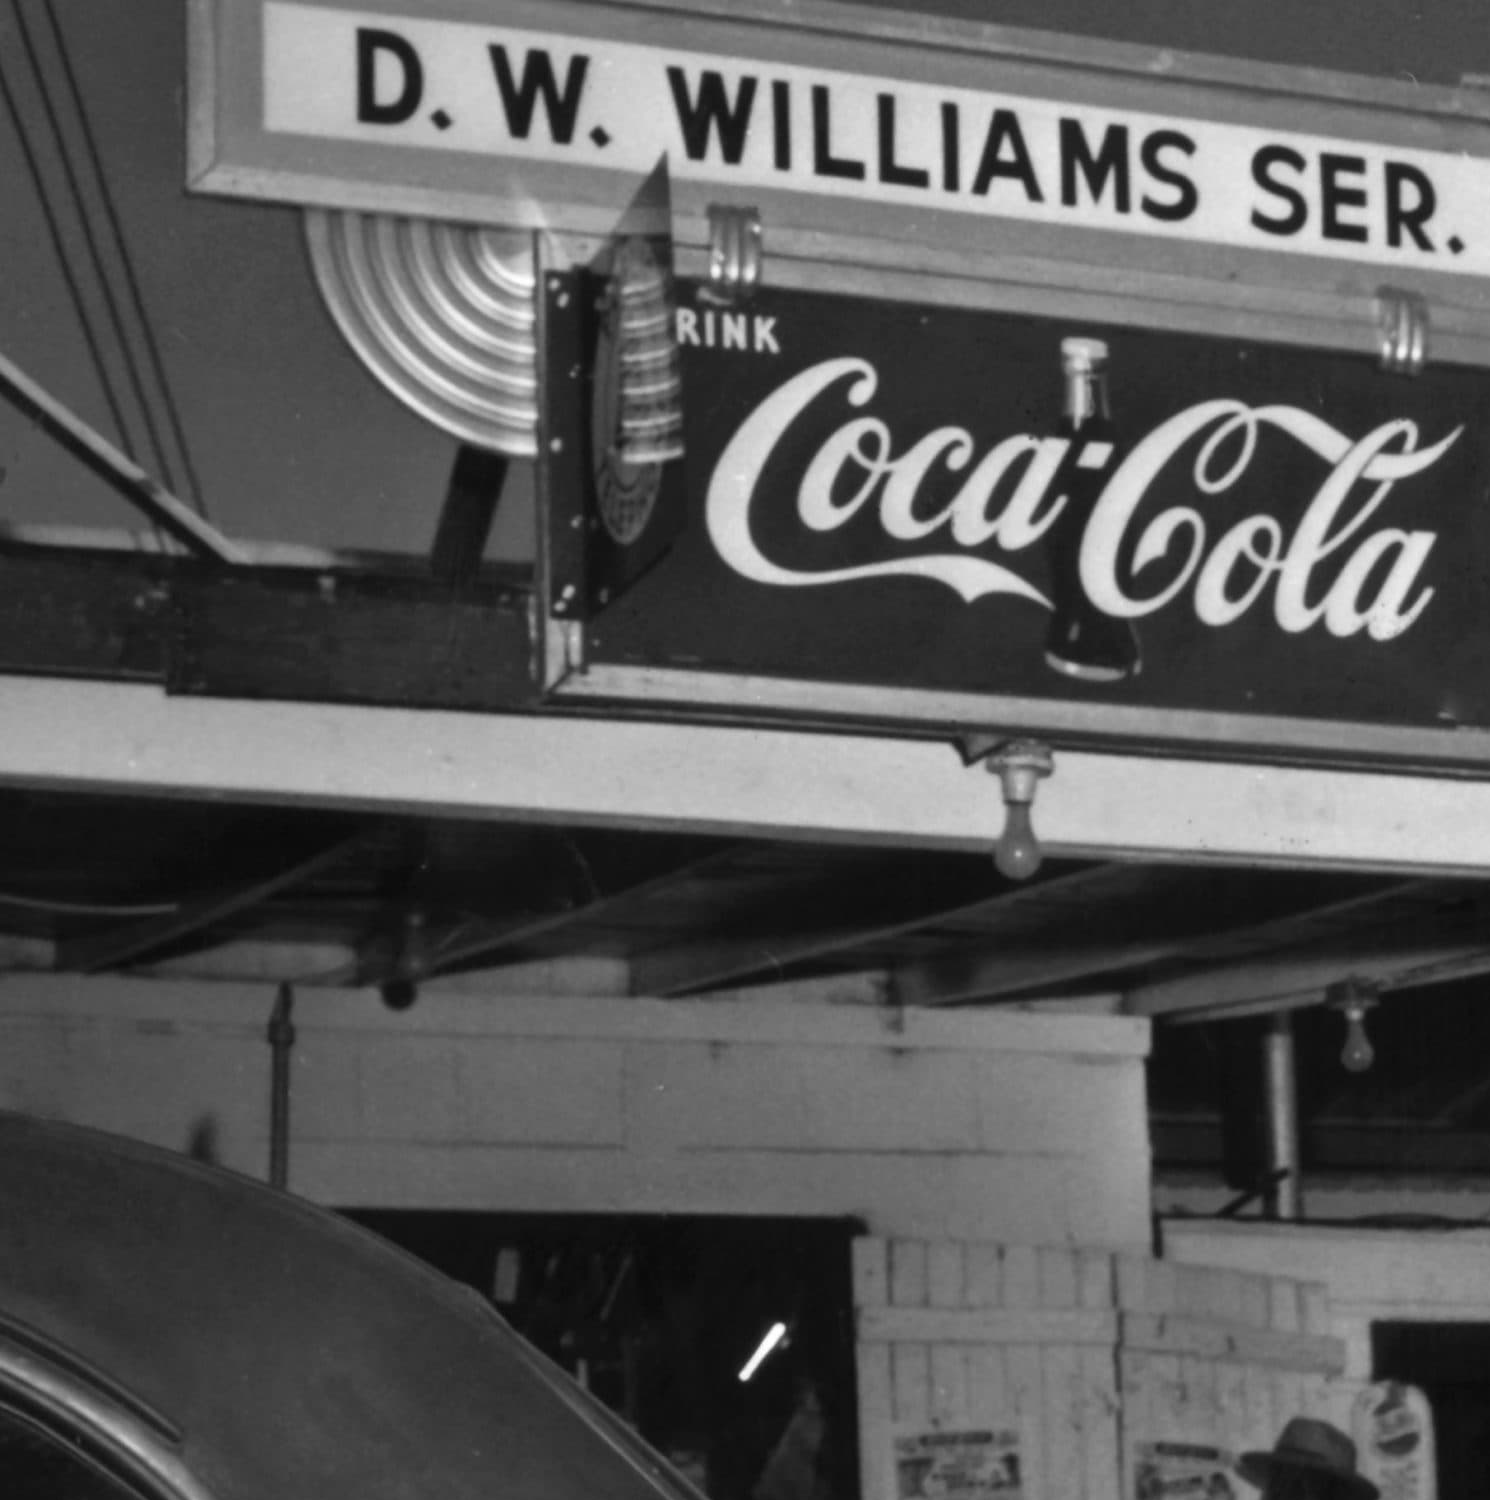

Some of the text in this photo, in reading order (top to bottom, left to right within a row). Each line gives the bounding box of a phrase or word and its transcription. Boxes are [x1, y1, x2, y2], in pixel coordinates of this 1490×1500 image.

[357, 27, 452, 131] D.
[488, 43, 610, 148] W.
[667, 65, 1198, 221] WILLIAMS
[1251, 144, 1466, 256] SER.
[675, 306, 780, 355] RINK
[706, 357, 1464, 642] Coca-Cola
